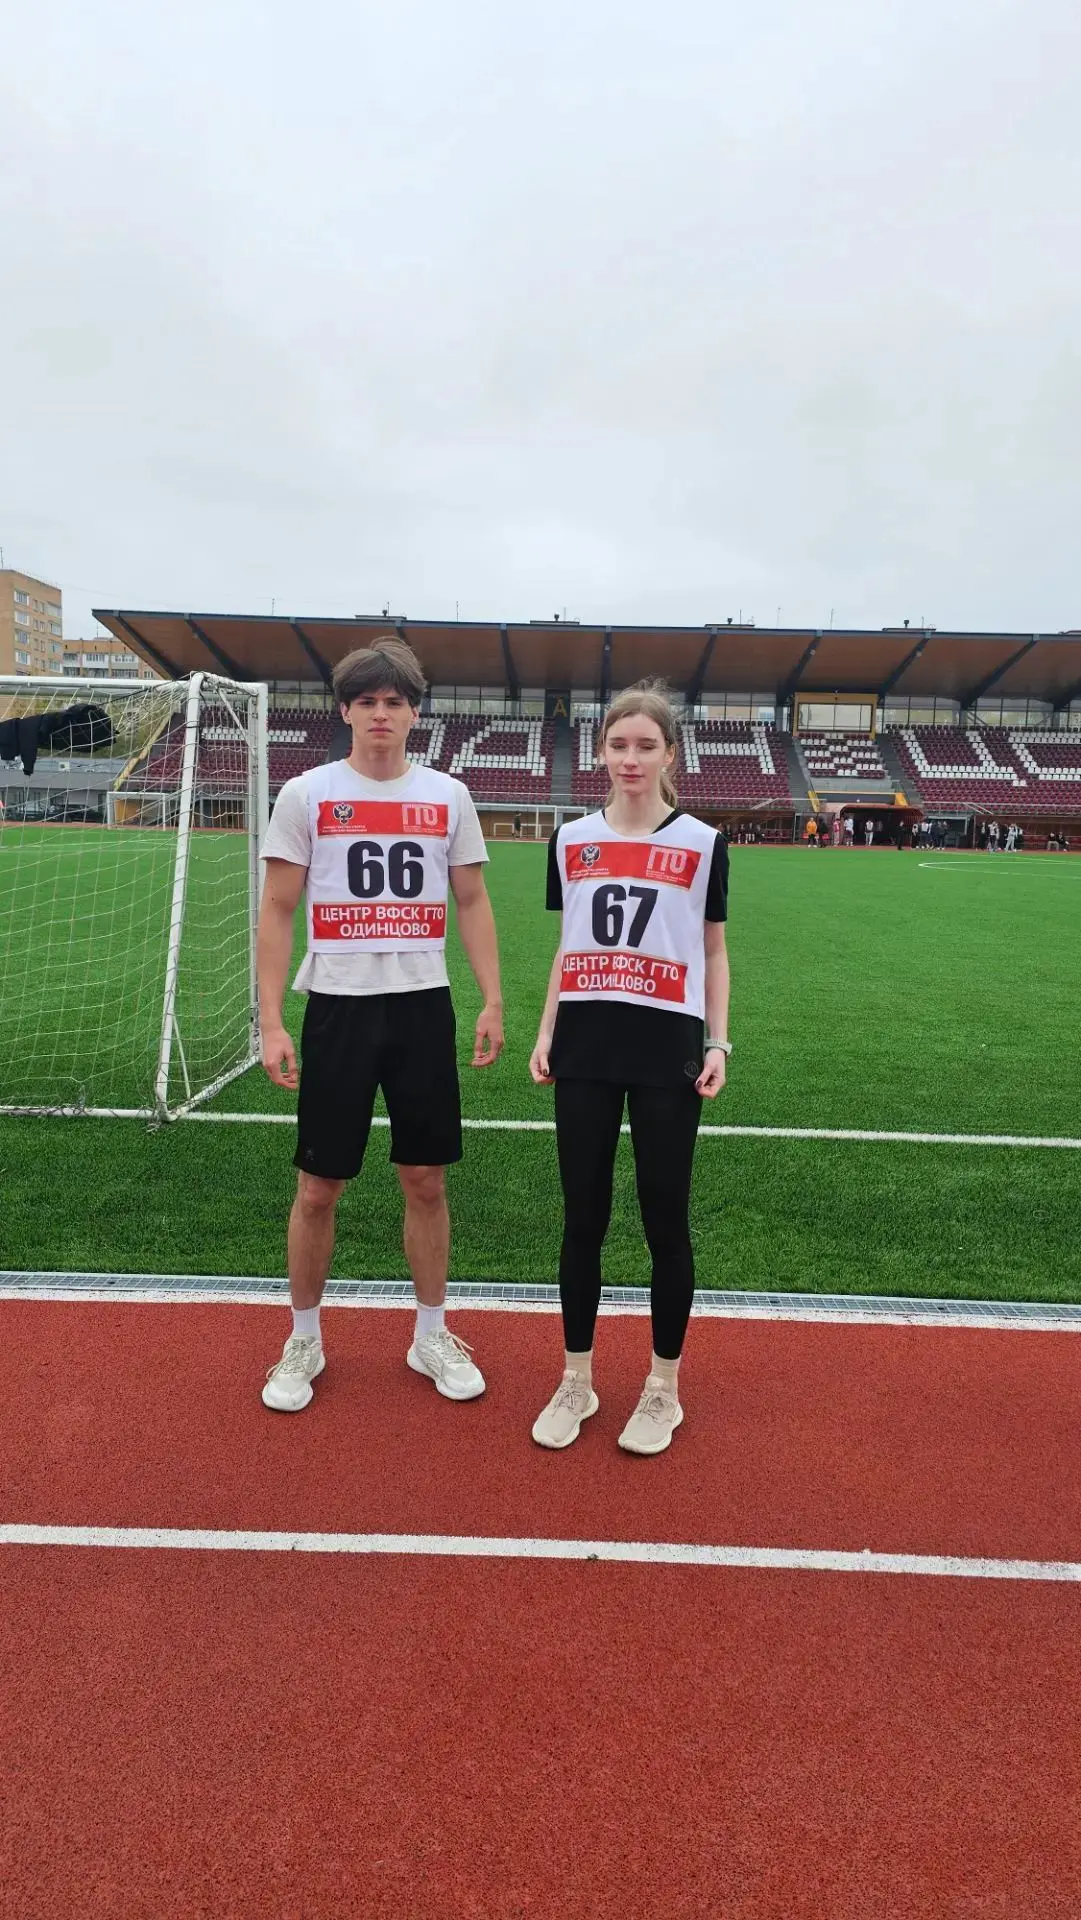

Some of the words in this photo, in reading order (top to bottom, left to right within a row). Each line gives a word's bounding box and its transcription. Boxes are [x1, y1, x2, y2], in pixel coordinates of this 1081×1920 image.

[401, 803, 439, 827] ГТО
[347, 840, 425, 899] 66
[646, 845, 688, 875] ГТО
[320, 906, 372, 923] ЦЕНТР
[376, 906, 420, 920] ВФСК
[424, 906, 444, 920] ГТО
[591, 883, 659, 948] 67
[339, 922, 430, 938] ОДИНЦОВО
[650, 961, 680, 981] ГТО
